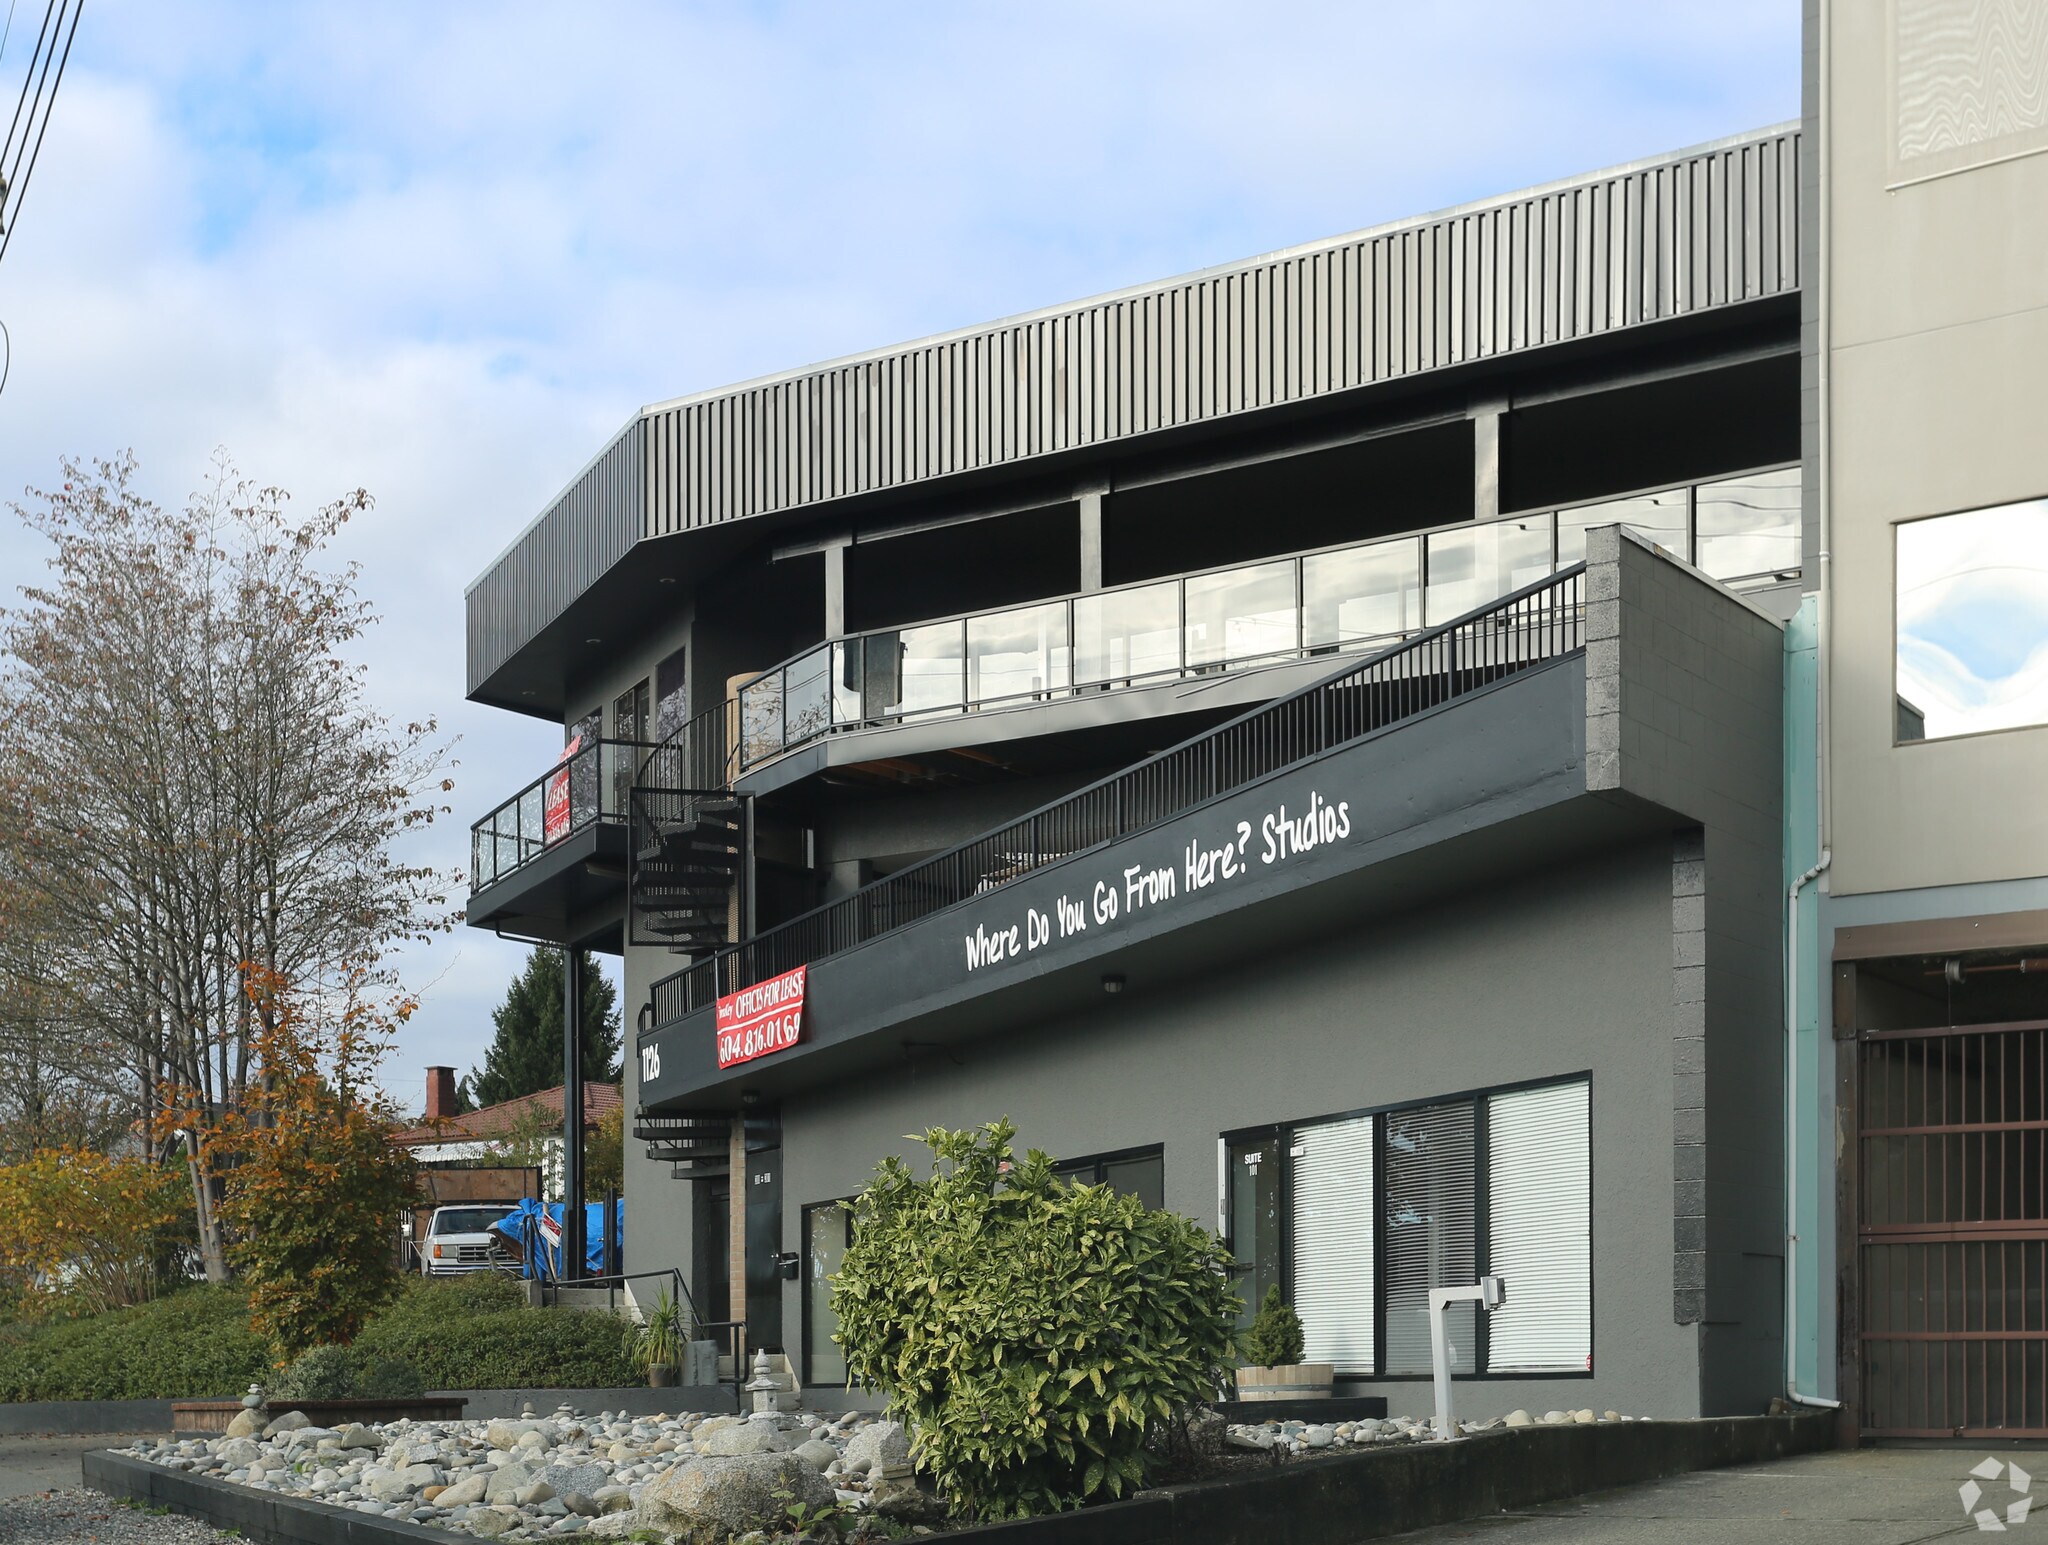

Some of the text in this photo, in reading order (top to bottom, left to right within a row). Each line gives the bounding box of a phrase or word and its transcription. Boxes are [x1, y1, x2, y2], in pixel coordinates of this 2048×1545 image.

[547, 779, 569, 811] LEASE
[965, 790, 1351, 972] Where Do You Go From Here? Studios
[735, 986, 763, 1019] OFFICES
[763, 980, 780, 1007] FOR
[780, 970, 804, 1002] LEASE
[642, 1043, 660, 1083] 1126
[1244, 1152, 1262, 1164] SUITE
